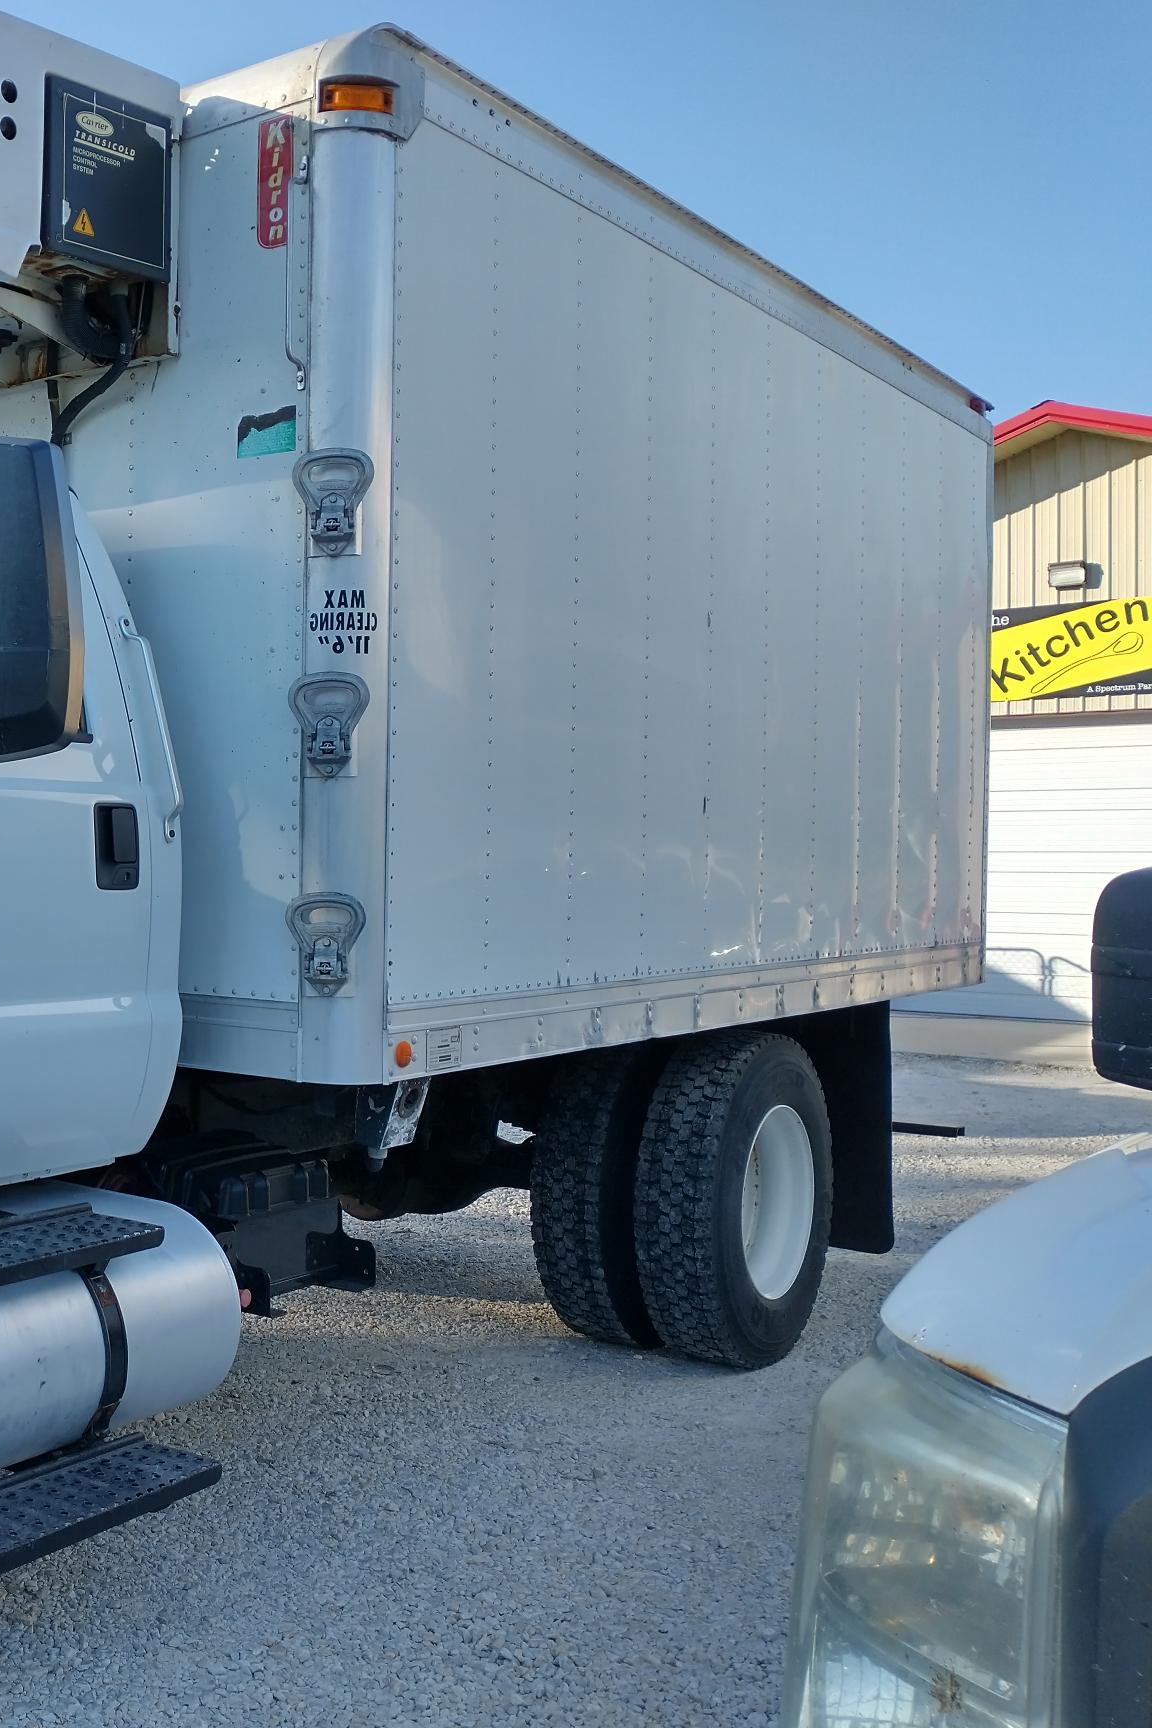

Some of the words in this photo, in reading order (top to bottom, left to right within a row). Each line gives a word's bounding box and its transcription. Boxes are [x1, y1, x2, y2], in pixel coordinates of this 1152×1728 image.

[81, 115, 109, 131] Carrier
[75, 130, 136, 156] TRANSICOLD
[72, 146, 121, 168] MICROPROCESSOR
[72, 155, 98, 169] CONTROL
[72, 163, 94, 175] SYSTEM
[266, 119, 286, 241] Kidron
[991, 614, 1010, 626] he
[991, 599, 1149, 693] Kitchen
[1086, 685, 1094, 693] A
[1095, 684, 1137, 693] Spectrum
